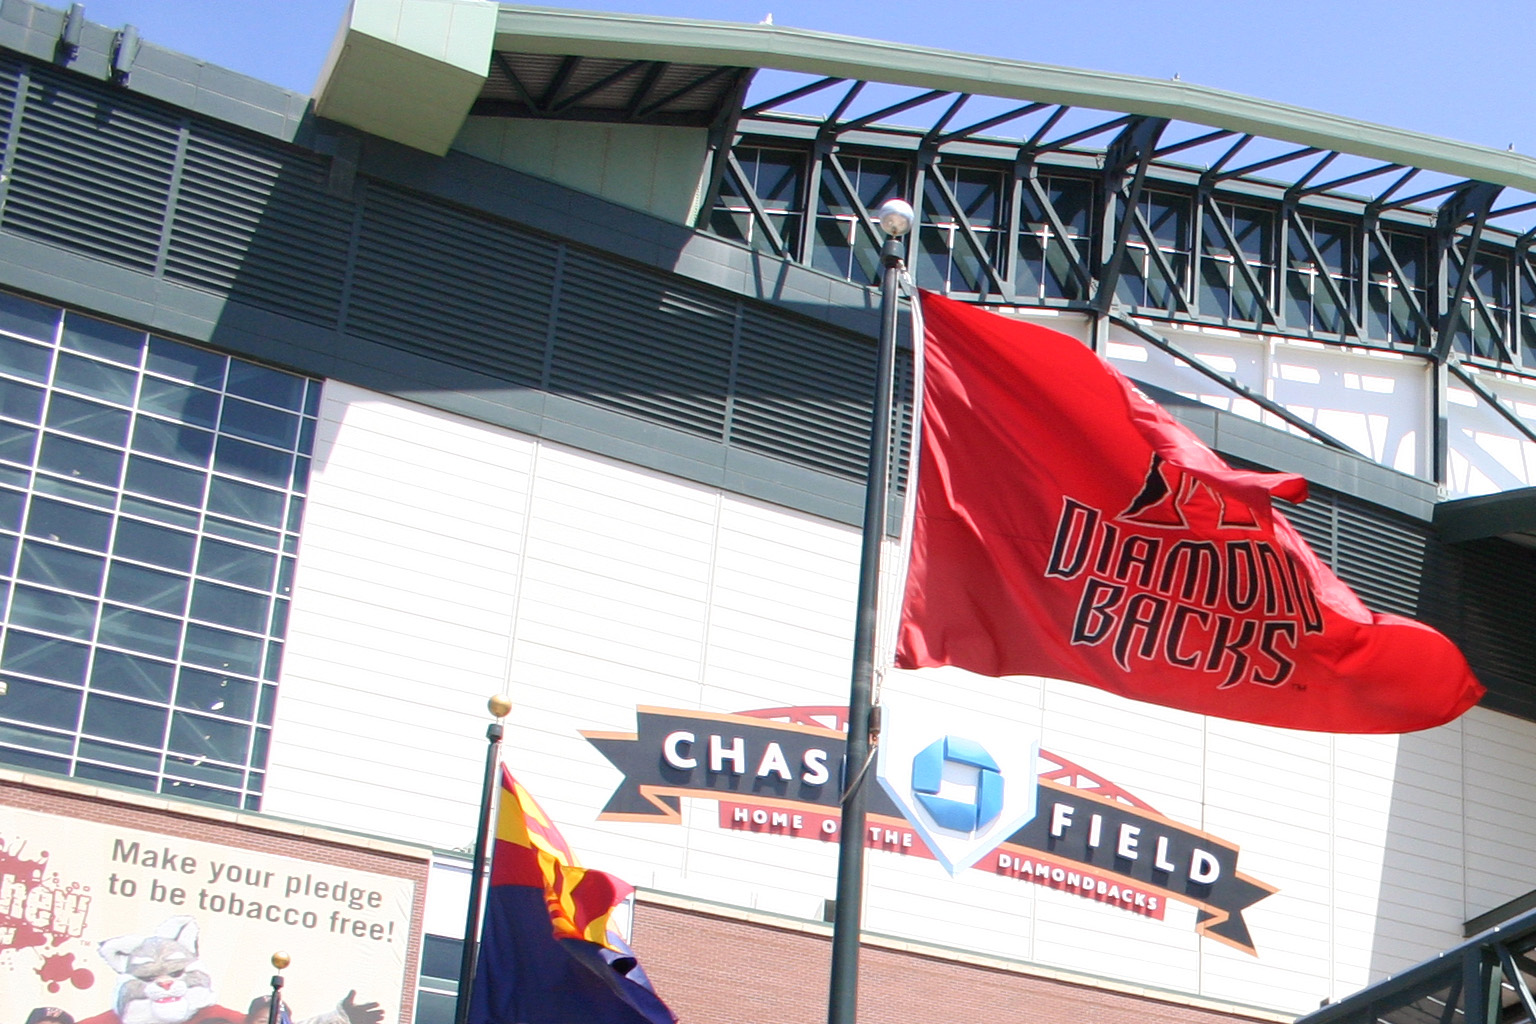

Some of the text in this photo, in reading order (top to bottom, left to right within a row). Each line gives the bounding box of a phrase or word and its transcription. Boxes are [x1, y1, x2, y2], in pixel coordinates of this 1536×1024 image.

[1045, 495, 1324, 636] DIAMOND
[1070, 577, 1298, 690] BACKS
[662, 730, 1220, 885] CHAS FIELD
[734, 807, 912, 848] HOME O THE
[0, 873, 92, 938] hew
[108, 873, 395, 943] to be tobacco free!
[111, 838, 383, 910] Make your pledge
[997, 853, 1157, 911] DIAMONDBACKS
